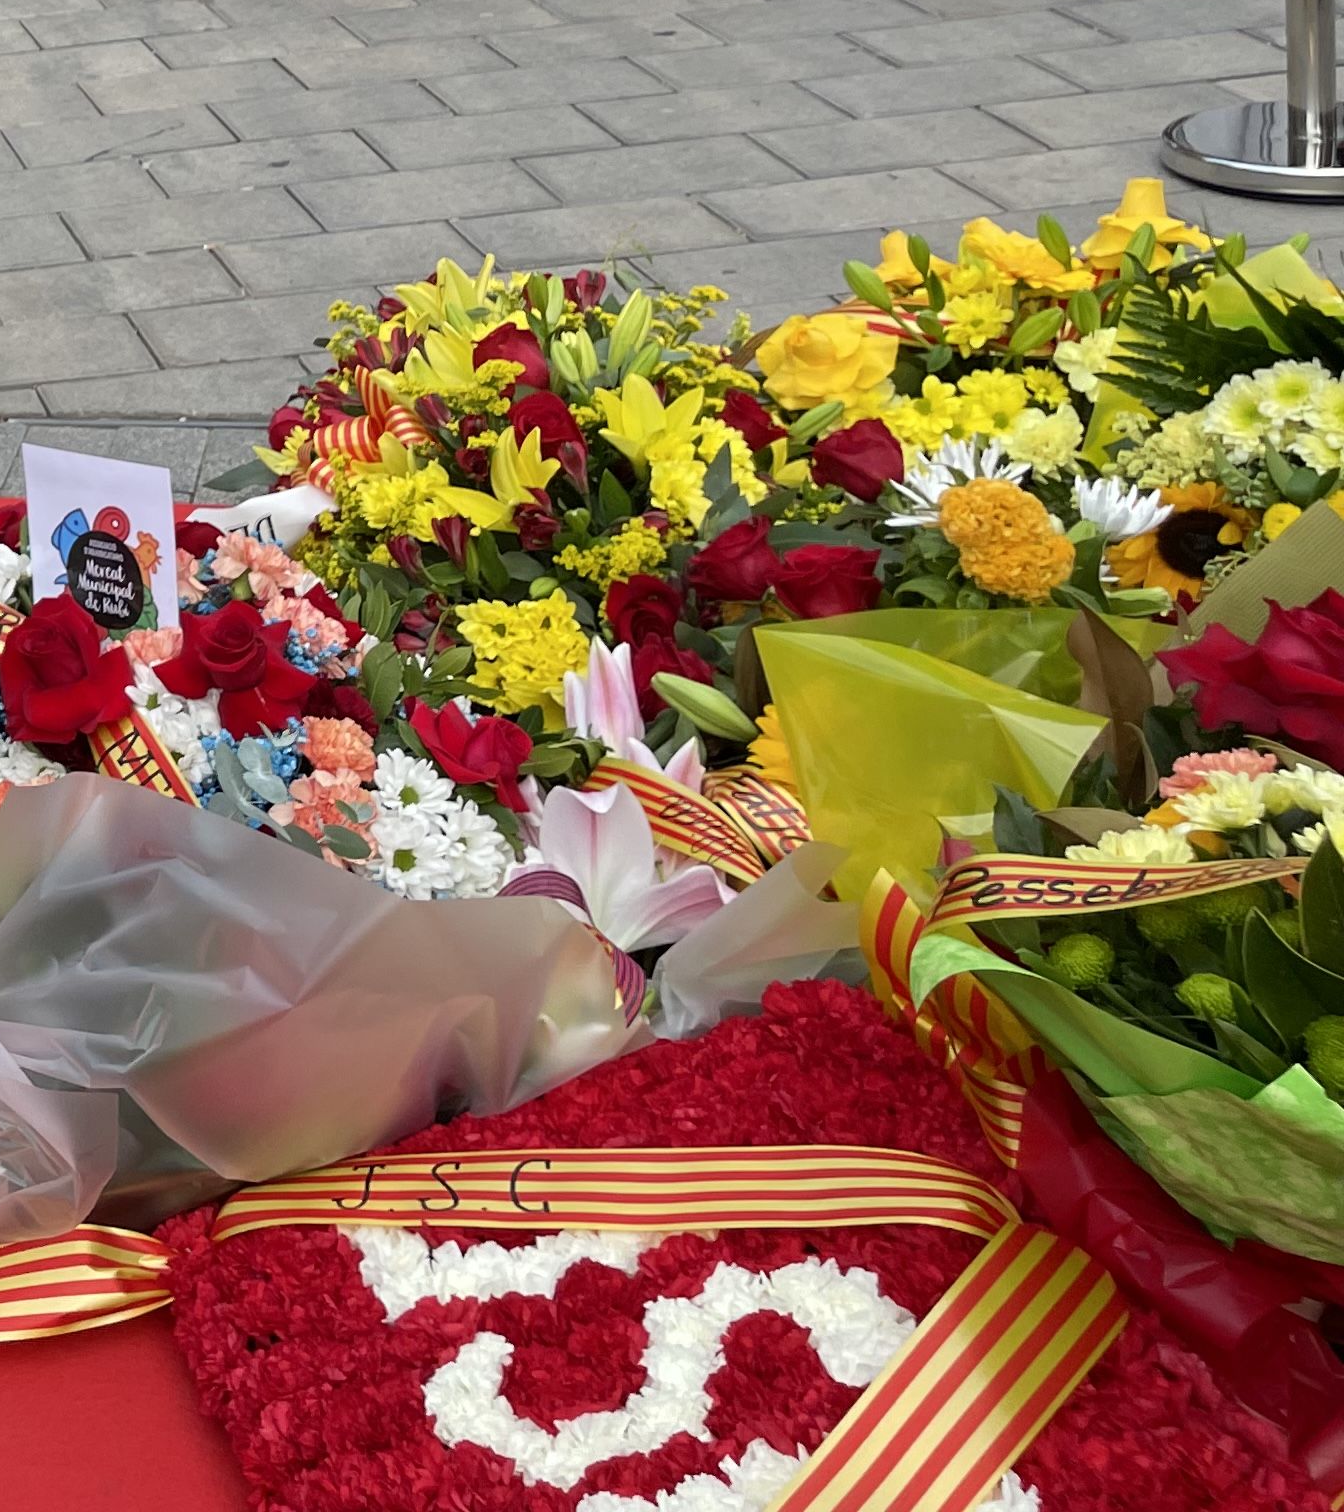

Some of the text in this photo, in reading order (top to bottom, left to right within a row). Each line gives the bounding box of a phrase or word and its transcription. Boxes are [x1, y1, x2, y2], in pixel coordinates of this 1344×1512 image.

[85, 559, 126, 582] Mercat
[77, 573, 136, 601] Municipal
[85, 591, 101, 612] de
